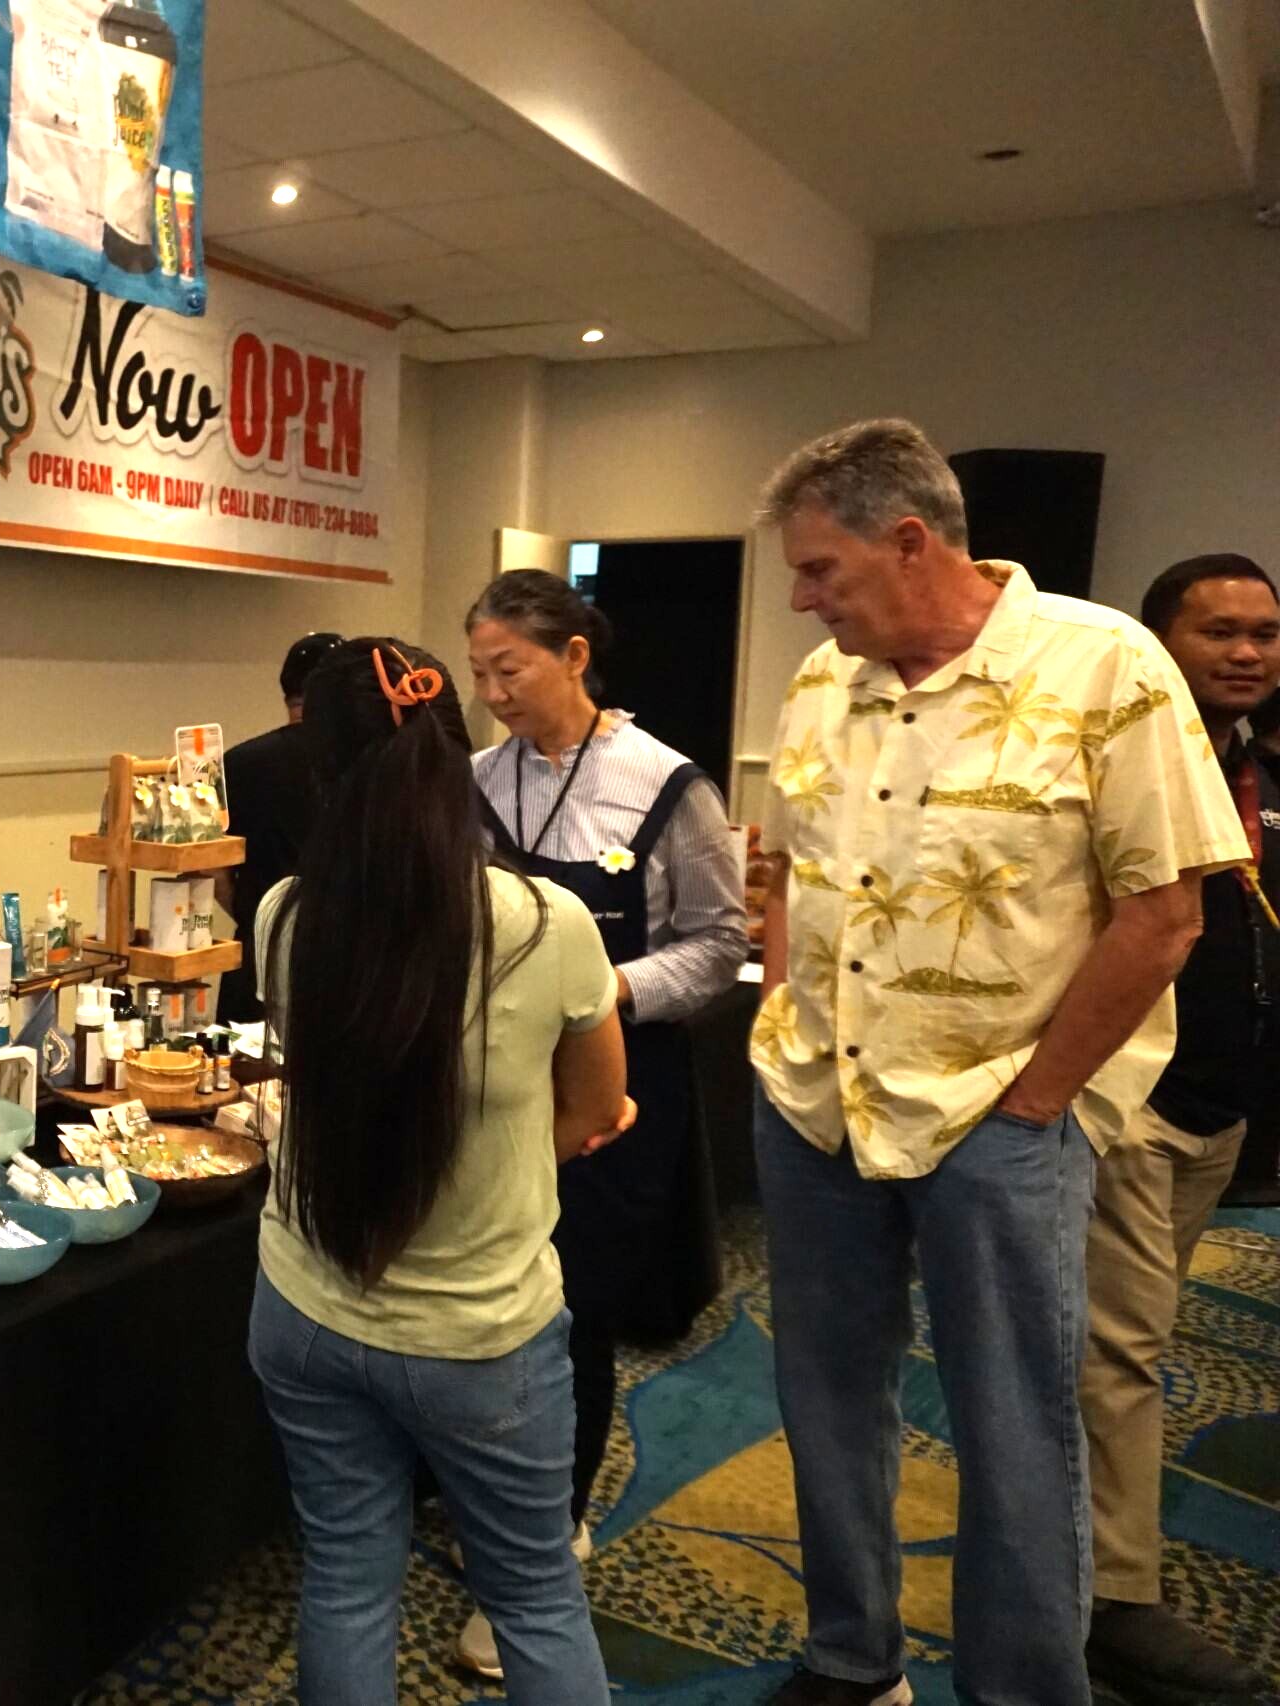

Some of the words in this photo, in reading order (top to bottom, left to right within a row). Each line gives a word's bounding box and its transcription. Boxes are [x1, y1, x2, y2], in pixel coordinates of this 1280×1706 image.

[60, 284, 222, 442] Now
[229, 332, 365, 478] OPEN
[29, 451, 73, 489] OPEN
[77, 460, 114, 496] 6AM
[126, 469, 160, 503] 9PM
[164, 476, 204, 510] DAILY
[220, 486, 250, 518] CALL
[254, 492, 270, 522] US
[272, 495, 289, 524] AT
